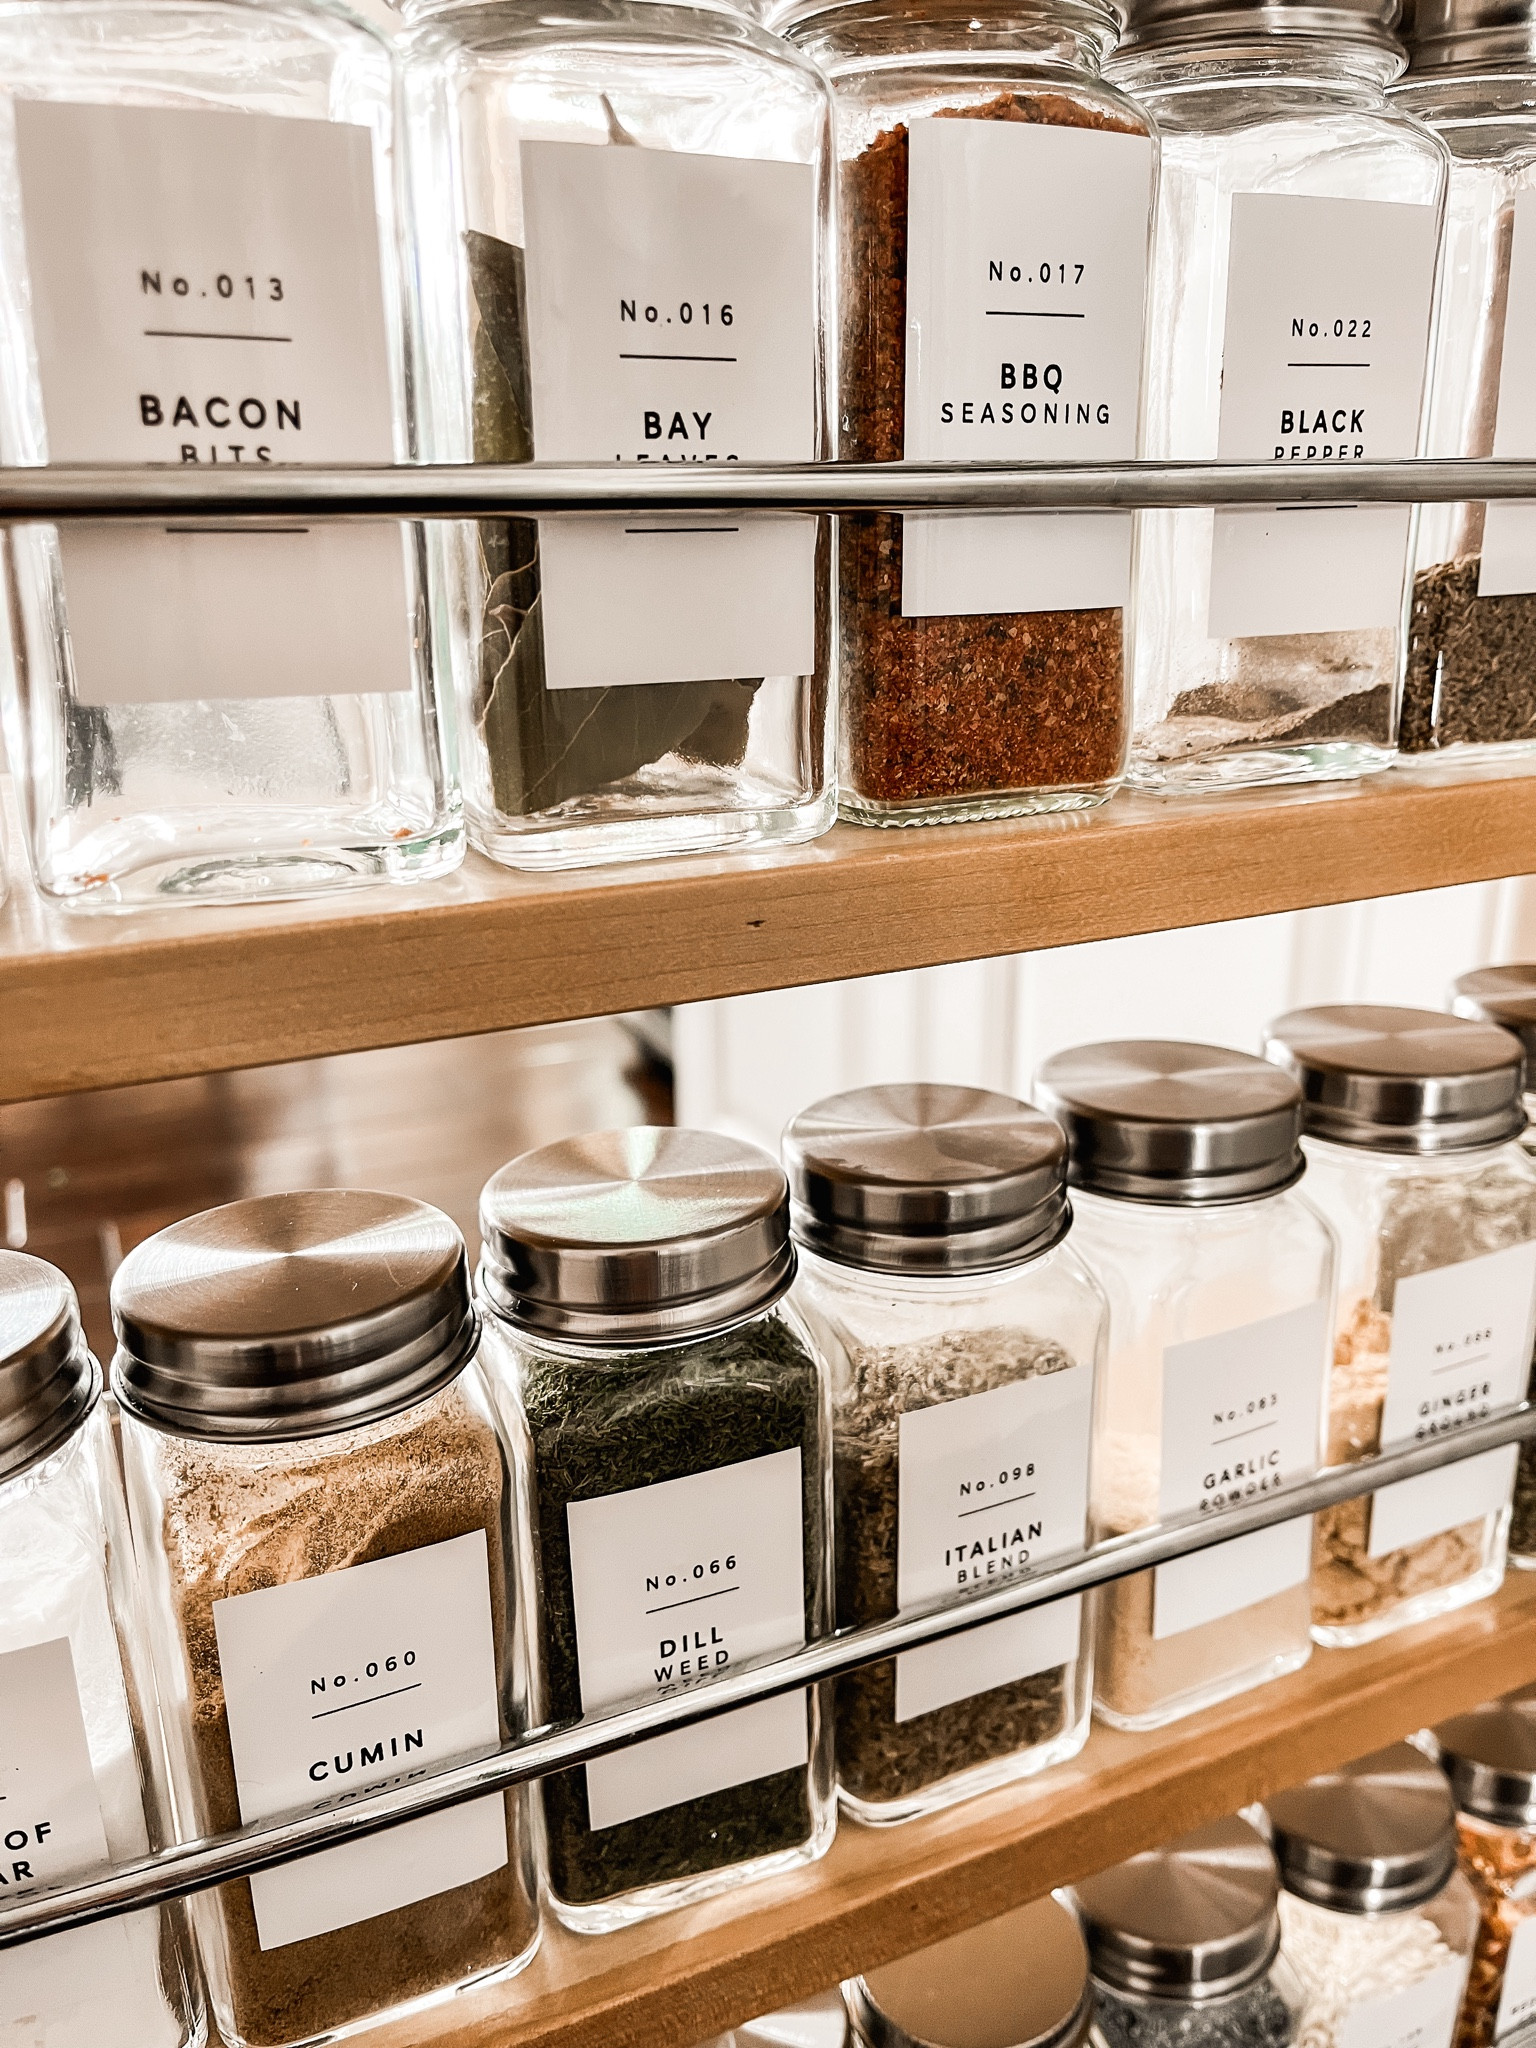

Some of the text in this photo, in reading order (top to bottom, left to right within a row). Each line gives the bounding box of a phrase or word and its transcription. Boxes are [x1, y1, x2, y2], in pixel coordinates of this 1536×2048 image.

[141, 270, 285, 302] No.013
[990, 261, 1086, 286] No.017
[621, 300, 735, 328] No.016
[1292, 319, 1372, 339] No.022
[1001, 363, 1064, 394] BBQ
[139, 394, 303, 432] BACON
[644, 411, 714, 441] BAY
[941, 403, 1111, 426] SEASONING
[1281, 410, 1365, 435] BLACK
[959, 1463, 1035, 1496] No.098
[1203, 1449, 1280, 1490] GARLIC
[945, 1521, 1043, 1566] ITALIAN
[646, 1555, 737, 1592] No.066
[957, 1550, 1030, 1584] BLEND
[660, 1626, 724, 1659] DILL
[310, 1650, 416, 1695] No.060
[654, 1650, 729, 1682] WEED
[308, 1728, 424, 1782] CUMIN
[4, 1821, 52, 1851] OF
